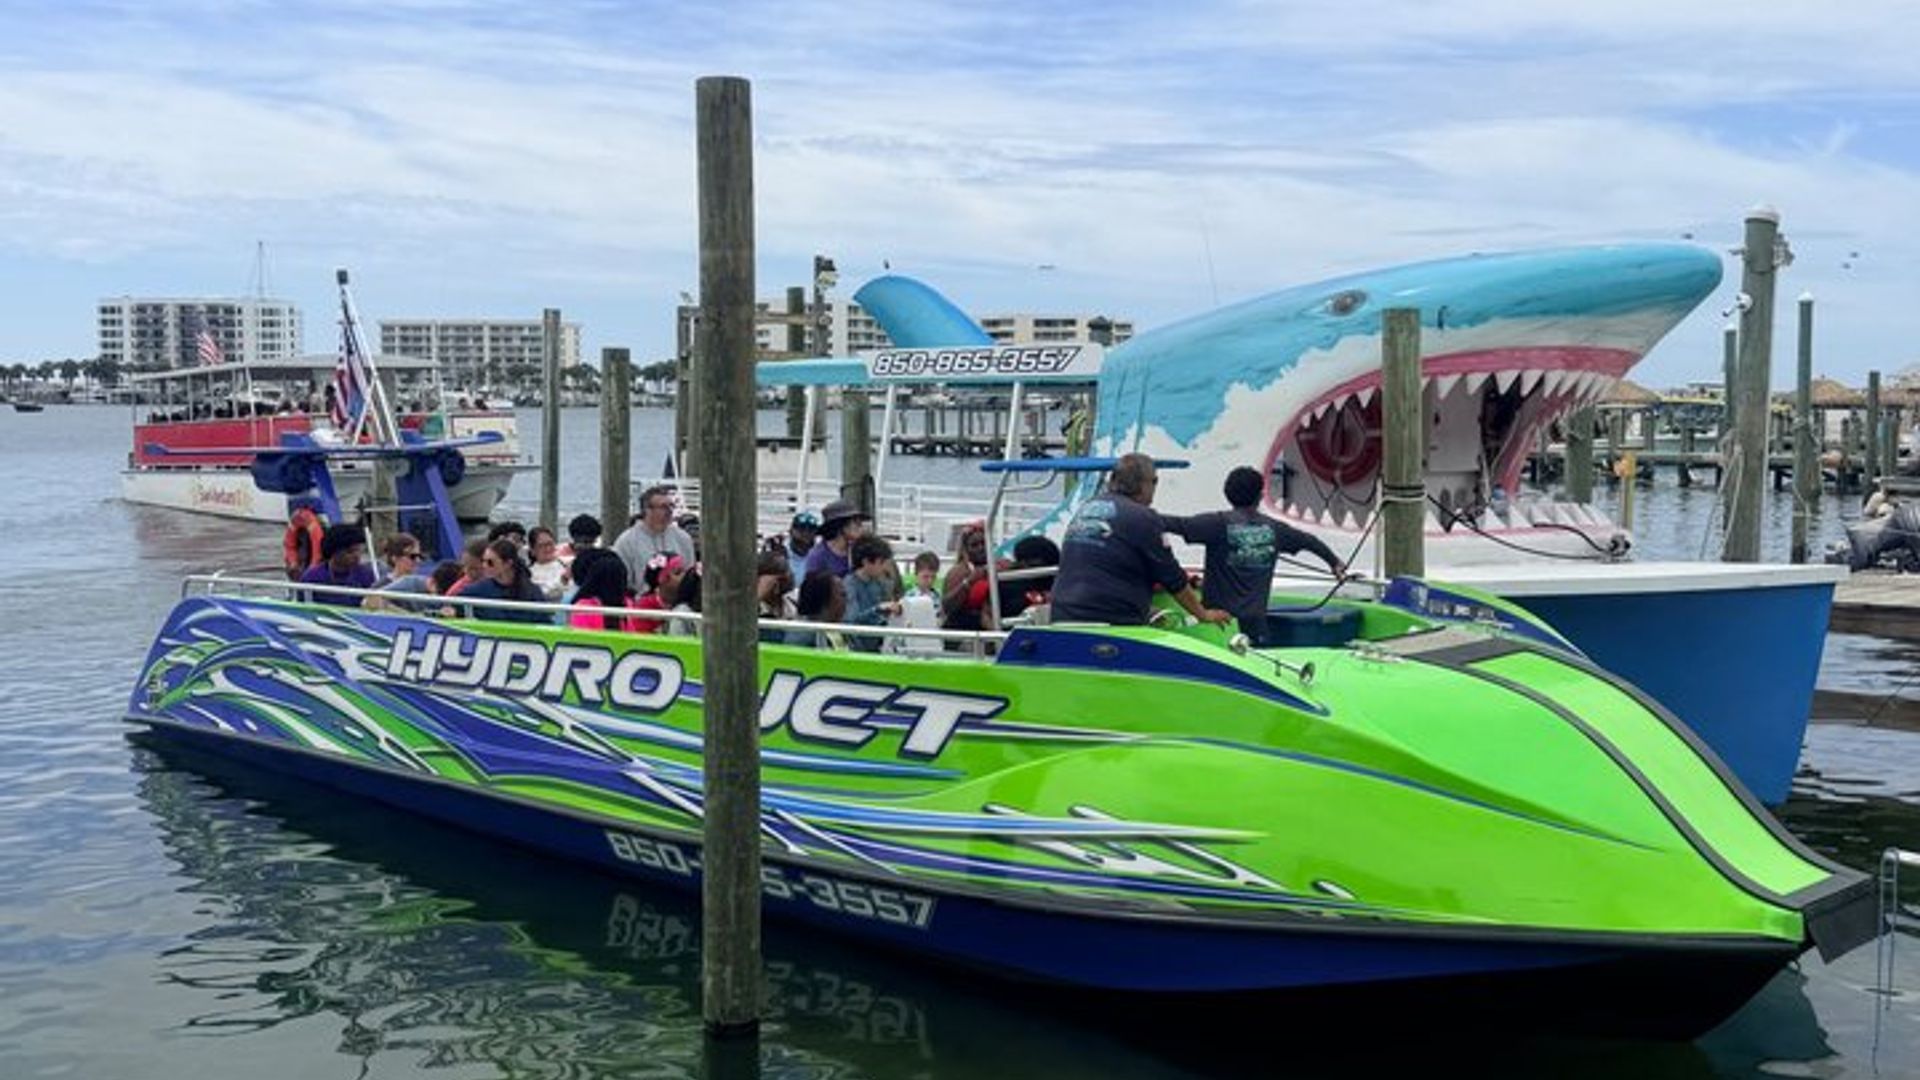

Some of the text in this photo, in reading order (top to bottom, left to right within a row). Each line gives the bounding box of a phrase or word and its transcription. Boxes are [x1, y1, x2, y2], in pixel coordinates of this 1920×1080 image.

[873, 347, 1081, 375] 850-865-3557
[386, 629, 1011, 760] HYDRO JET
[604, 831, 937, 928] 850-5-3557
